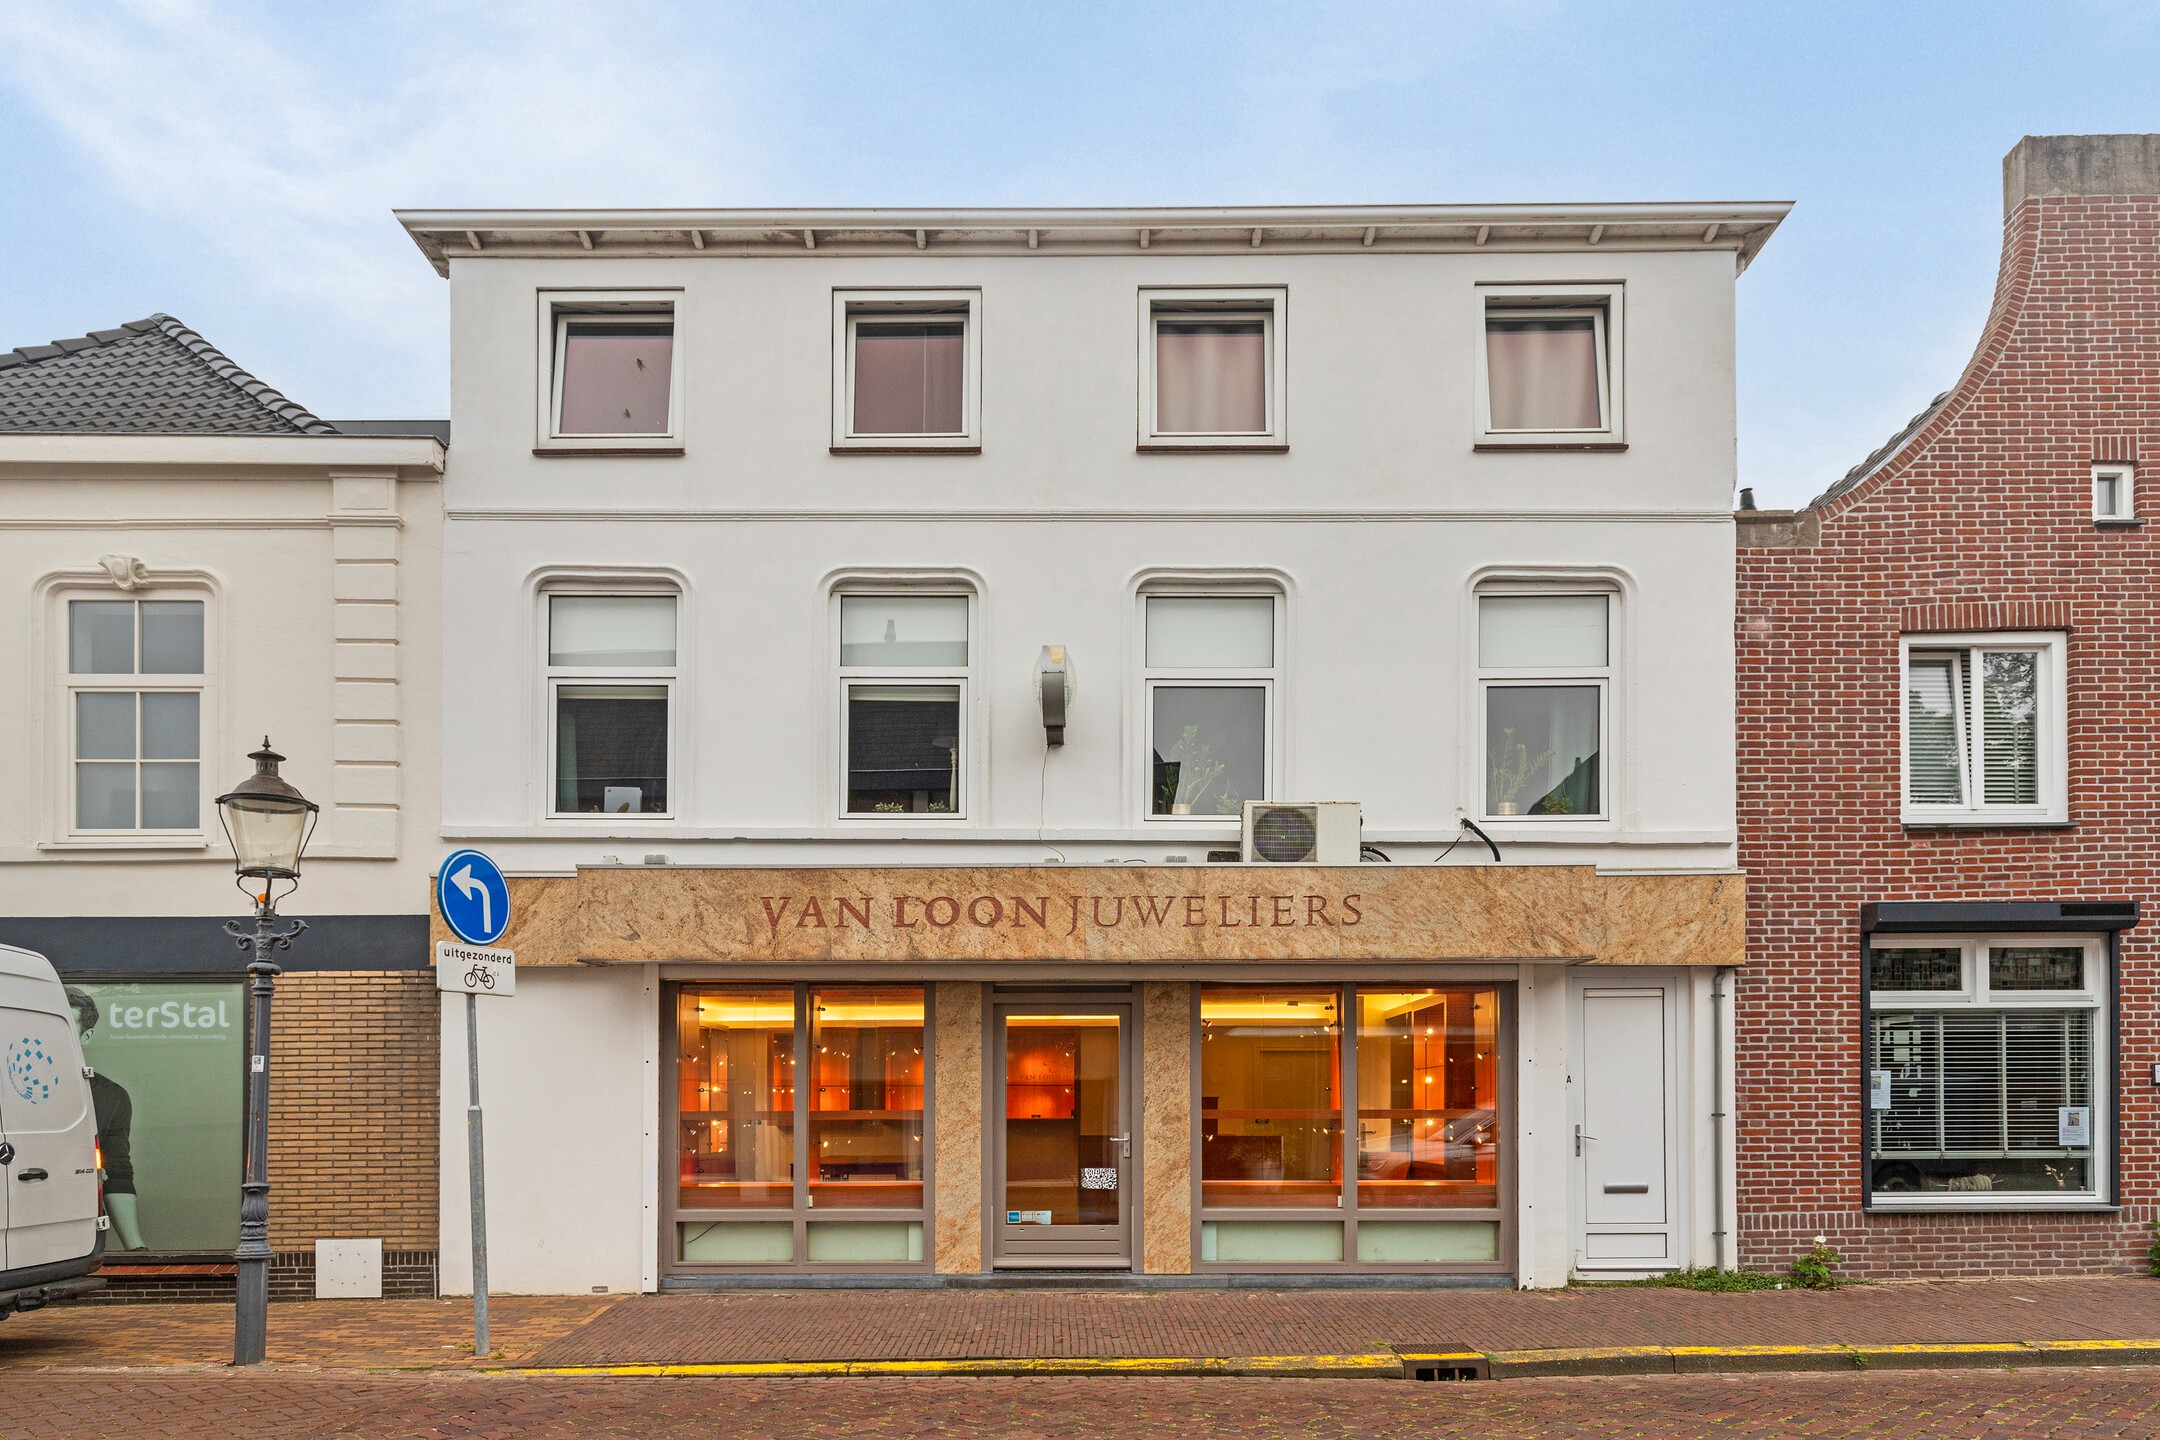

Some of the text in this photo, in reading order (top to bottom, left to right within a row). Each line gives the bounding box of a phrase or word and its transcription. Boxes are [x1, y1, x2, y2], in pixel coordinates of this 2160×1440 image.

[761, 894, 1362, 936] VAN LOON JUWELIERS
[444, 947, 512, 964] uitgezonderd
[109, 1000, 230, 1028] terStal
